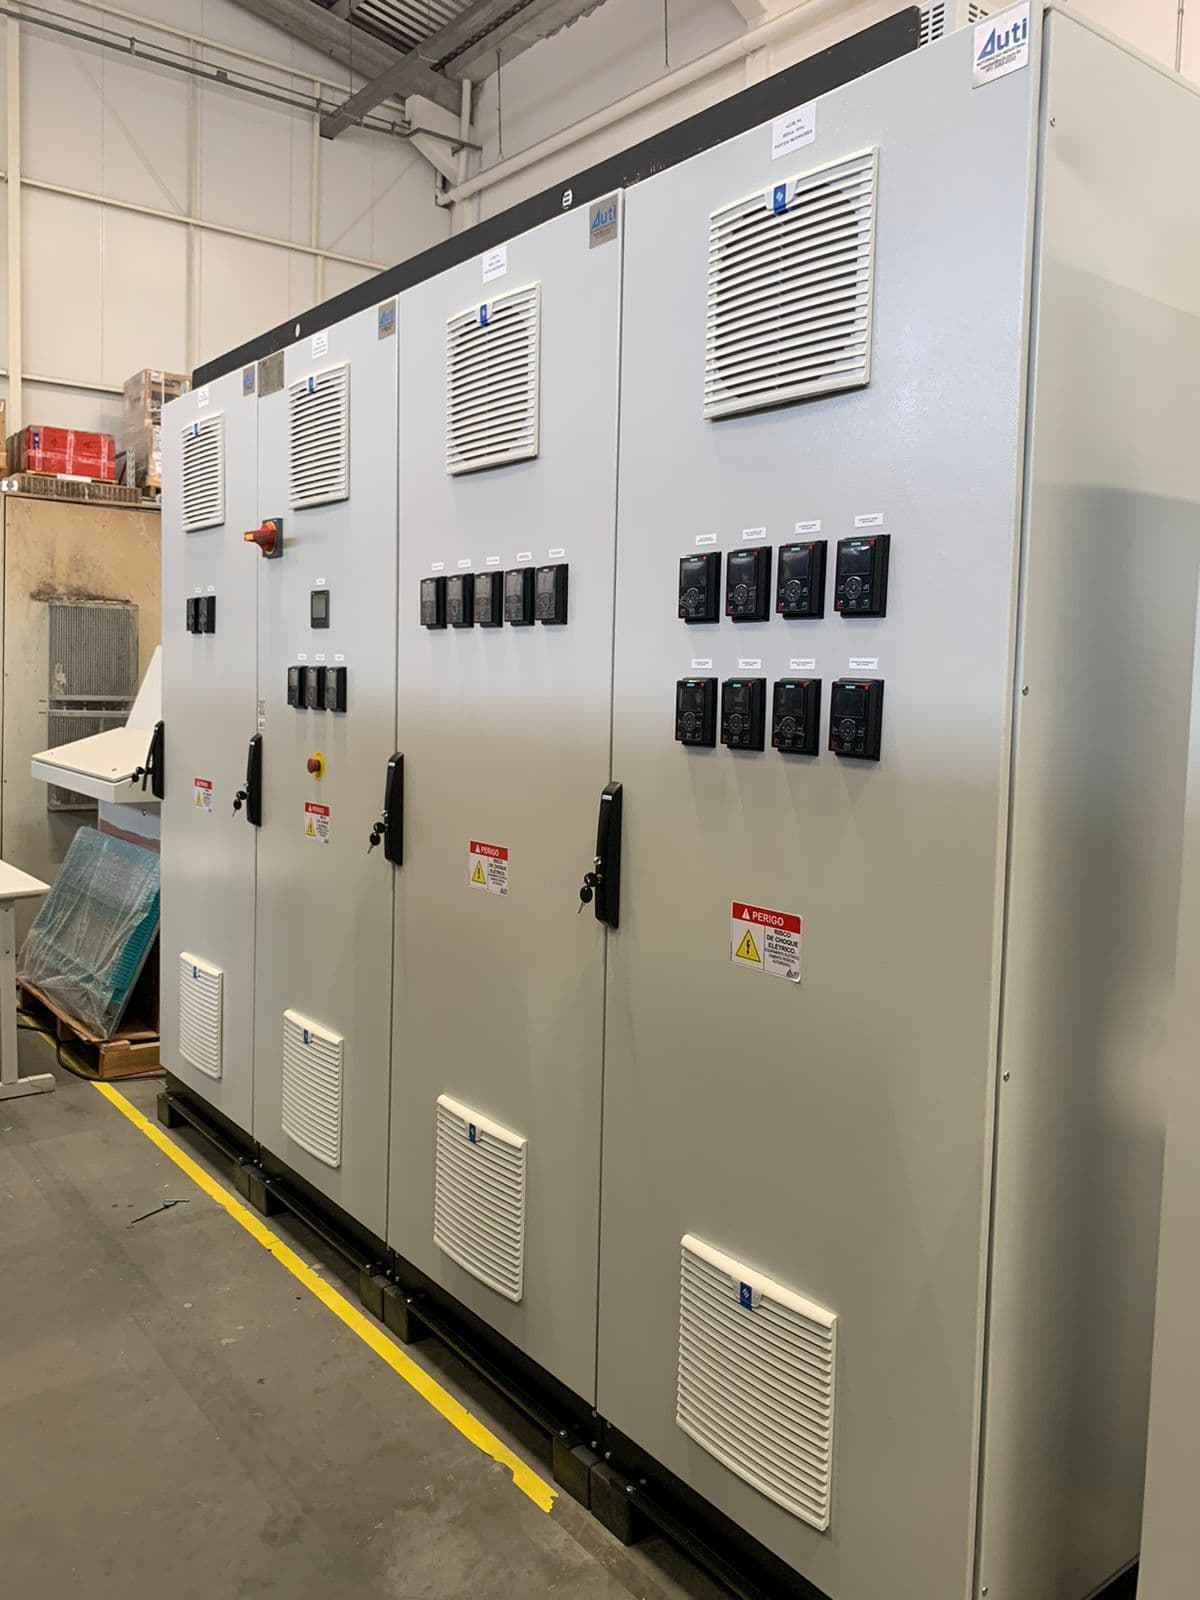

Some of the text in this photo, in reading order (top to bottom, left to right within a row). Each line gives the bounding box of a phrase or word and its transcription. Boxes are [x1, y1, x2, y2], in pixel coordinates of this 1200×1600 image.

[976, 17, 1027, 61] Auti
[752, 911, 784, 926] PERIGO
[774, 929, 791, 939] RISCO
[775, 936, 798, 948] CHOQUE
